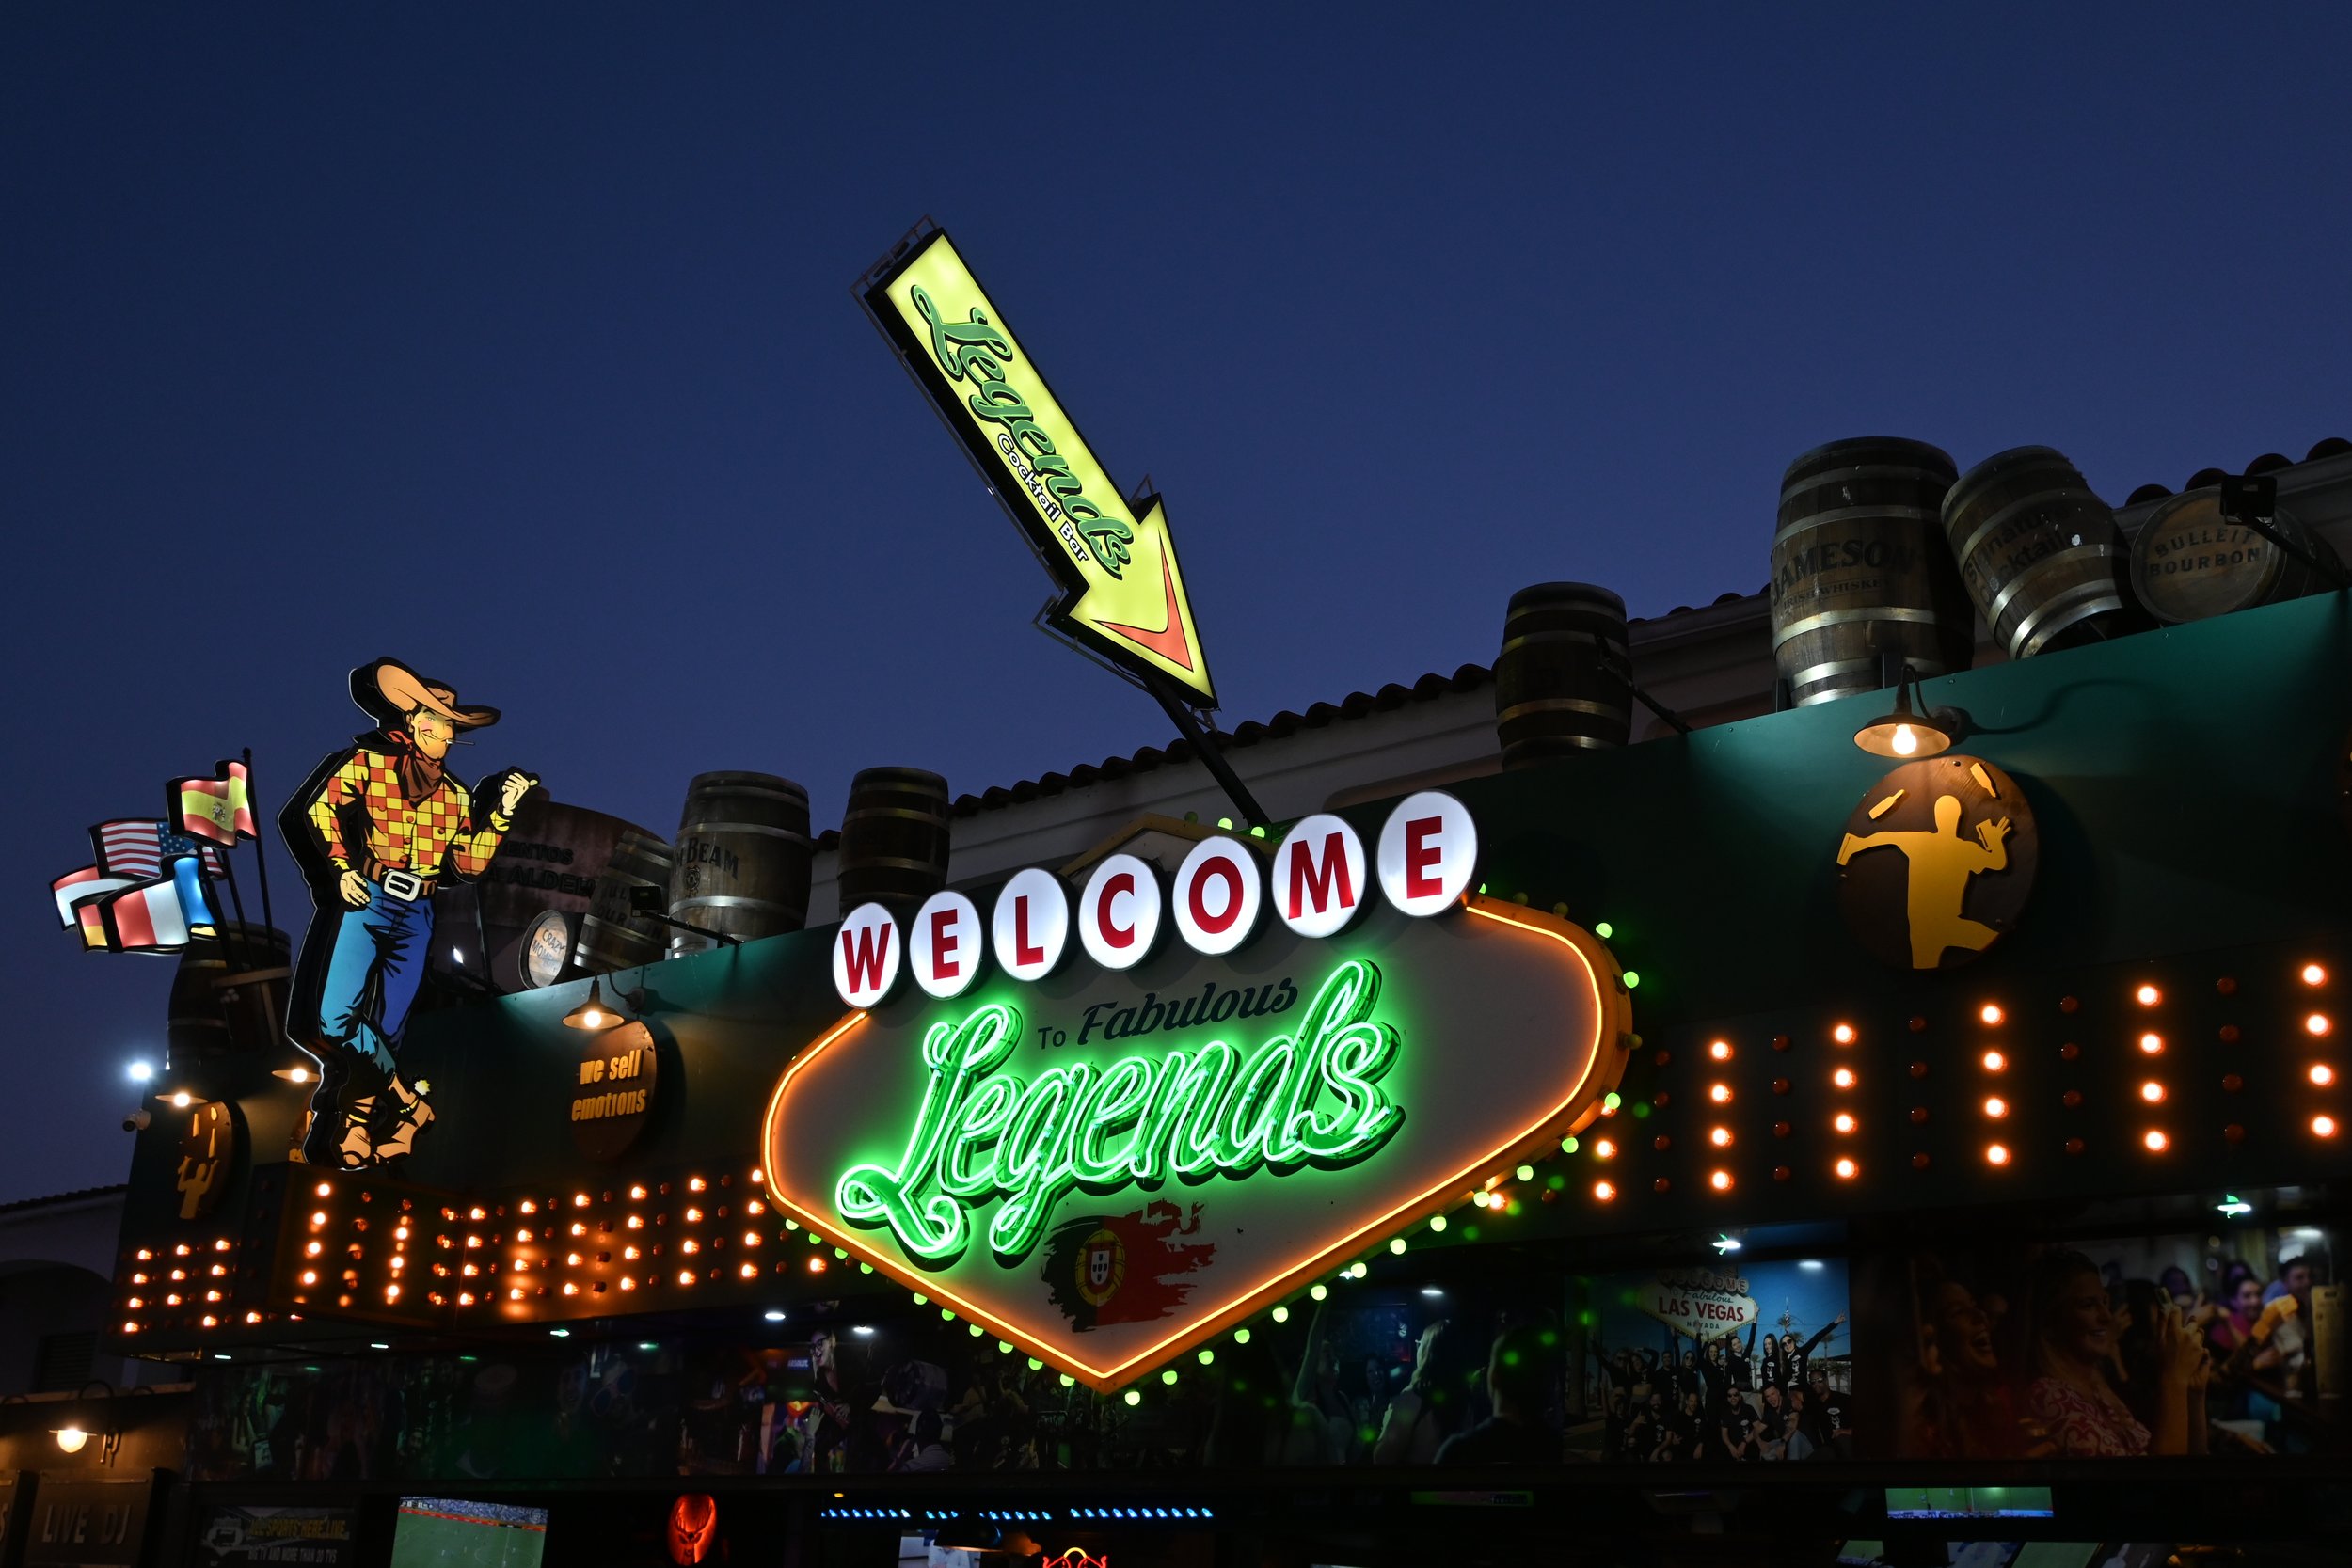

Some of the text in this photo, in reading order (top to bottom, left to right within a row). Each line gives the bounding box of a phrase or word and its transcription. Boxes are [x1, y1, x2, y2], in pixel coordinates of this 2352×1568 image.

[910, 284, 1135, 580] Legends
[997, 433, 1089, 562] Cocktail Bar
[2150, 547, 2260, 576] BOURBON
[2154, 527, 2255, 558] BULLEIT
[1773, 539, 1915, 607] JAMESON
[686, 838, 739, 881] BEAM
[841, 815, 1444, 995] WELCOME
[542, 928, 566, 954] CRAZY
[1077, 975, 1299, 1046] Fabulous
[580, 1049, 644, 1085] we sell
[571, 1088, 649, 1122] emotions
[835, 958, 1407, 1272] Legends
[1658, 1294, 1745, 1323] LAS VEGAS
[1681, 1288, 1733, 1304] Fabulous
[41, 1504, 133, 1544] LIVE DJ
